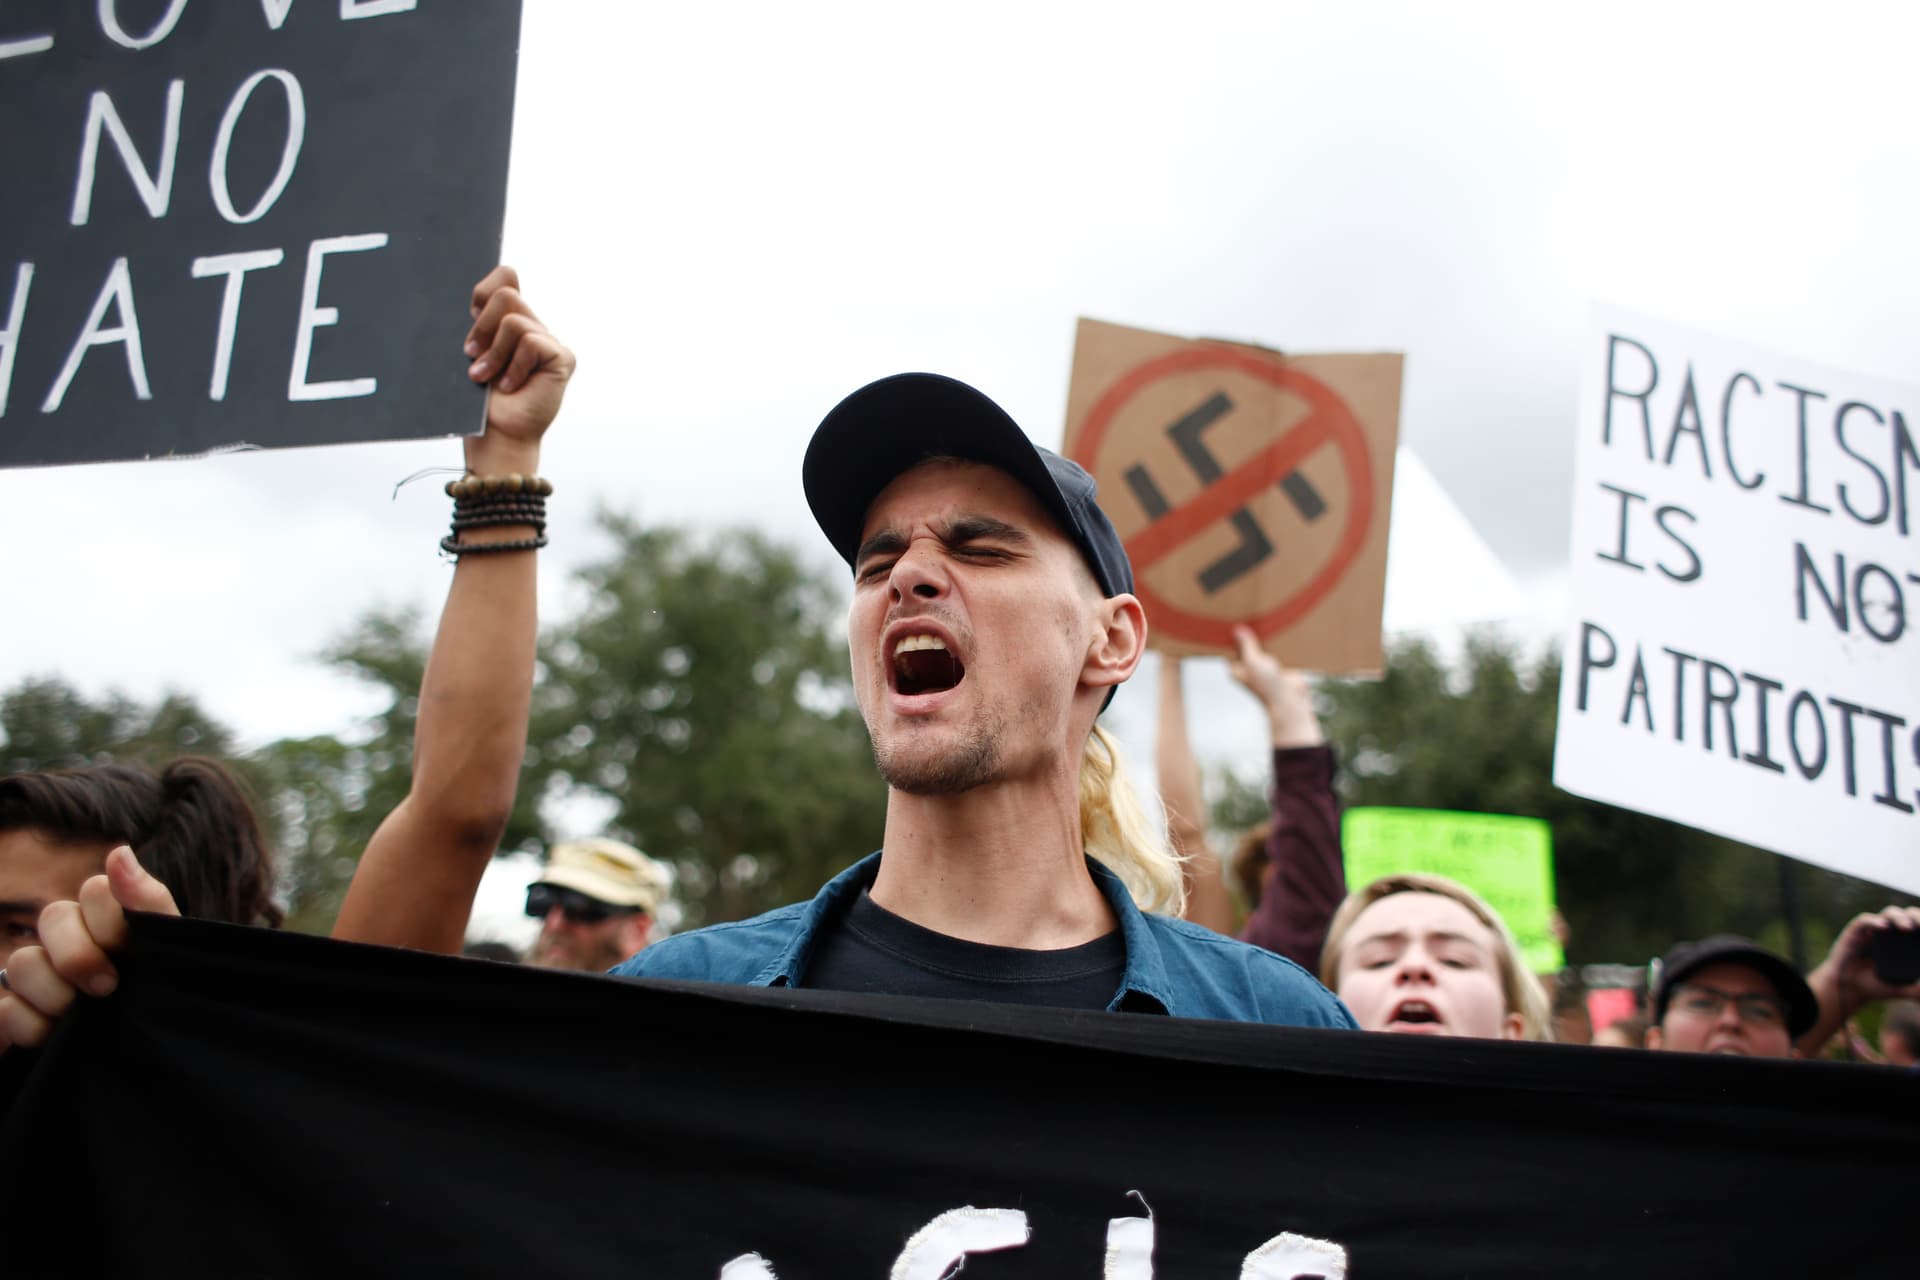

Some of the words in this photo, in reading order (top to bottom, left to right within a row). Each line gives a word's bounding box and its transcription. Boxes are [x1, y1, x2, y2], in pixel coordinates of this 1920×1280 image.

[70, 68, 306, 226] NO
[1597, 482, 1703, 583] IS
[1794, 541, 1920, 644] NO
[1575, 621, 1920, 815] PATRIOTI
